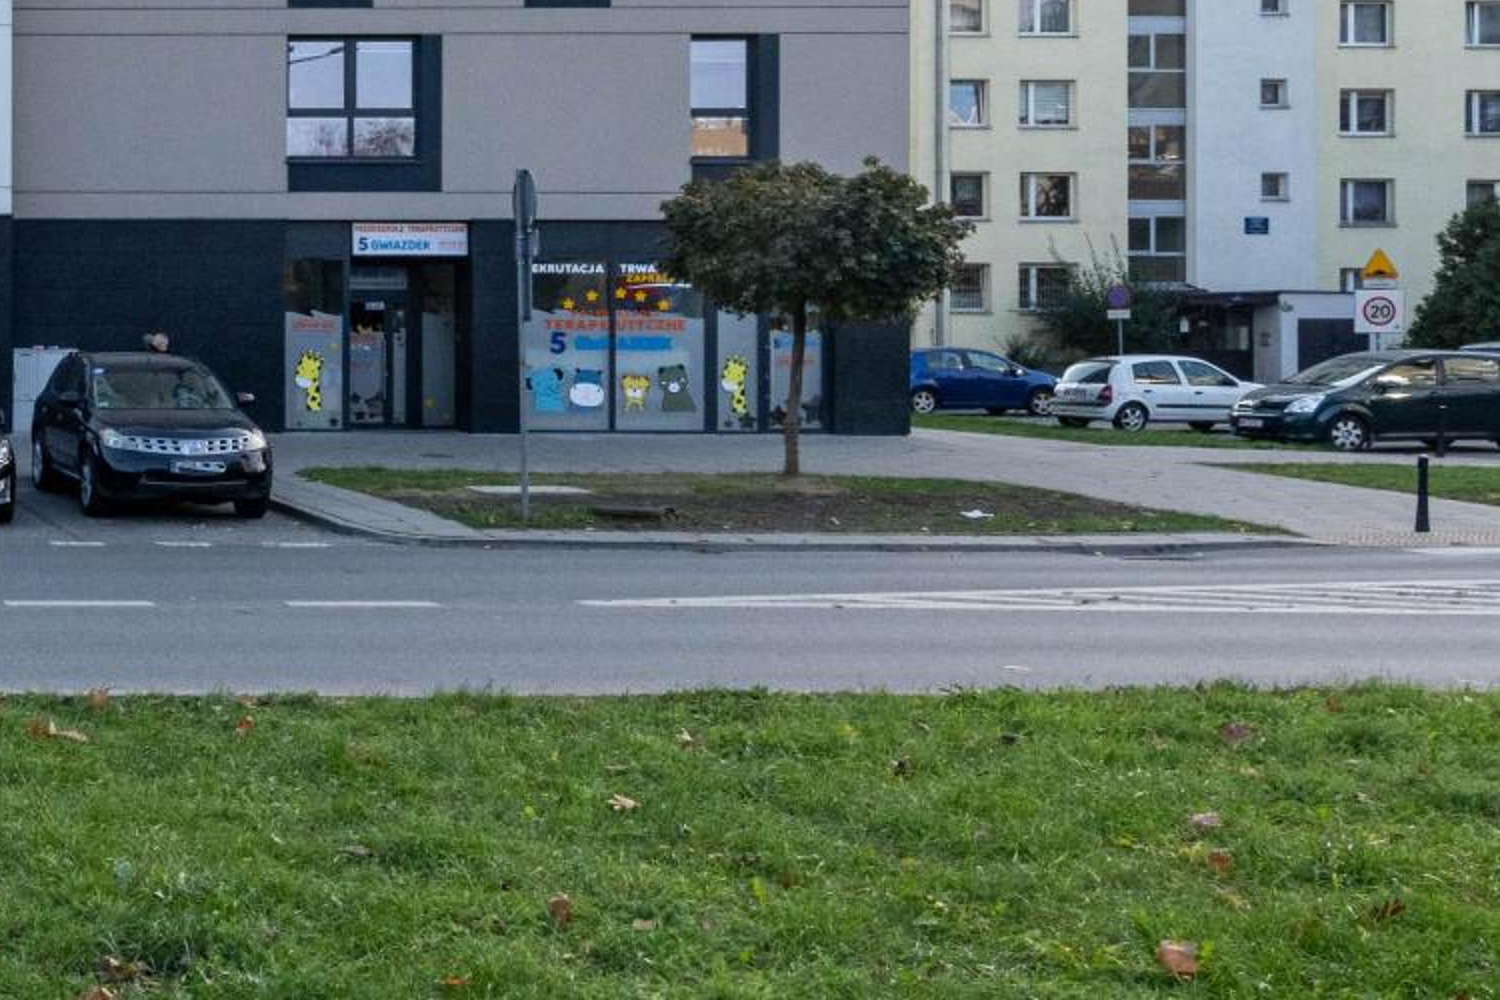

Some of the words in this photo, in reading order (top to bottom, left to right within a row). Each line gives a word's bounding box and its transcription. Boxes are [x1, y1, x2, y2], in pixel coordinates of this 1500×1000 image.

[358, 237, 368, 251] 5
[531, 263, 605, 274] EKRUTACJA
[1371, 304, 1390, 318] 20
[550, 331, 567, 354] 5
